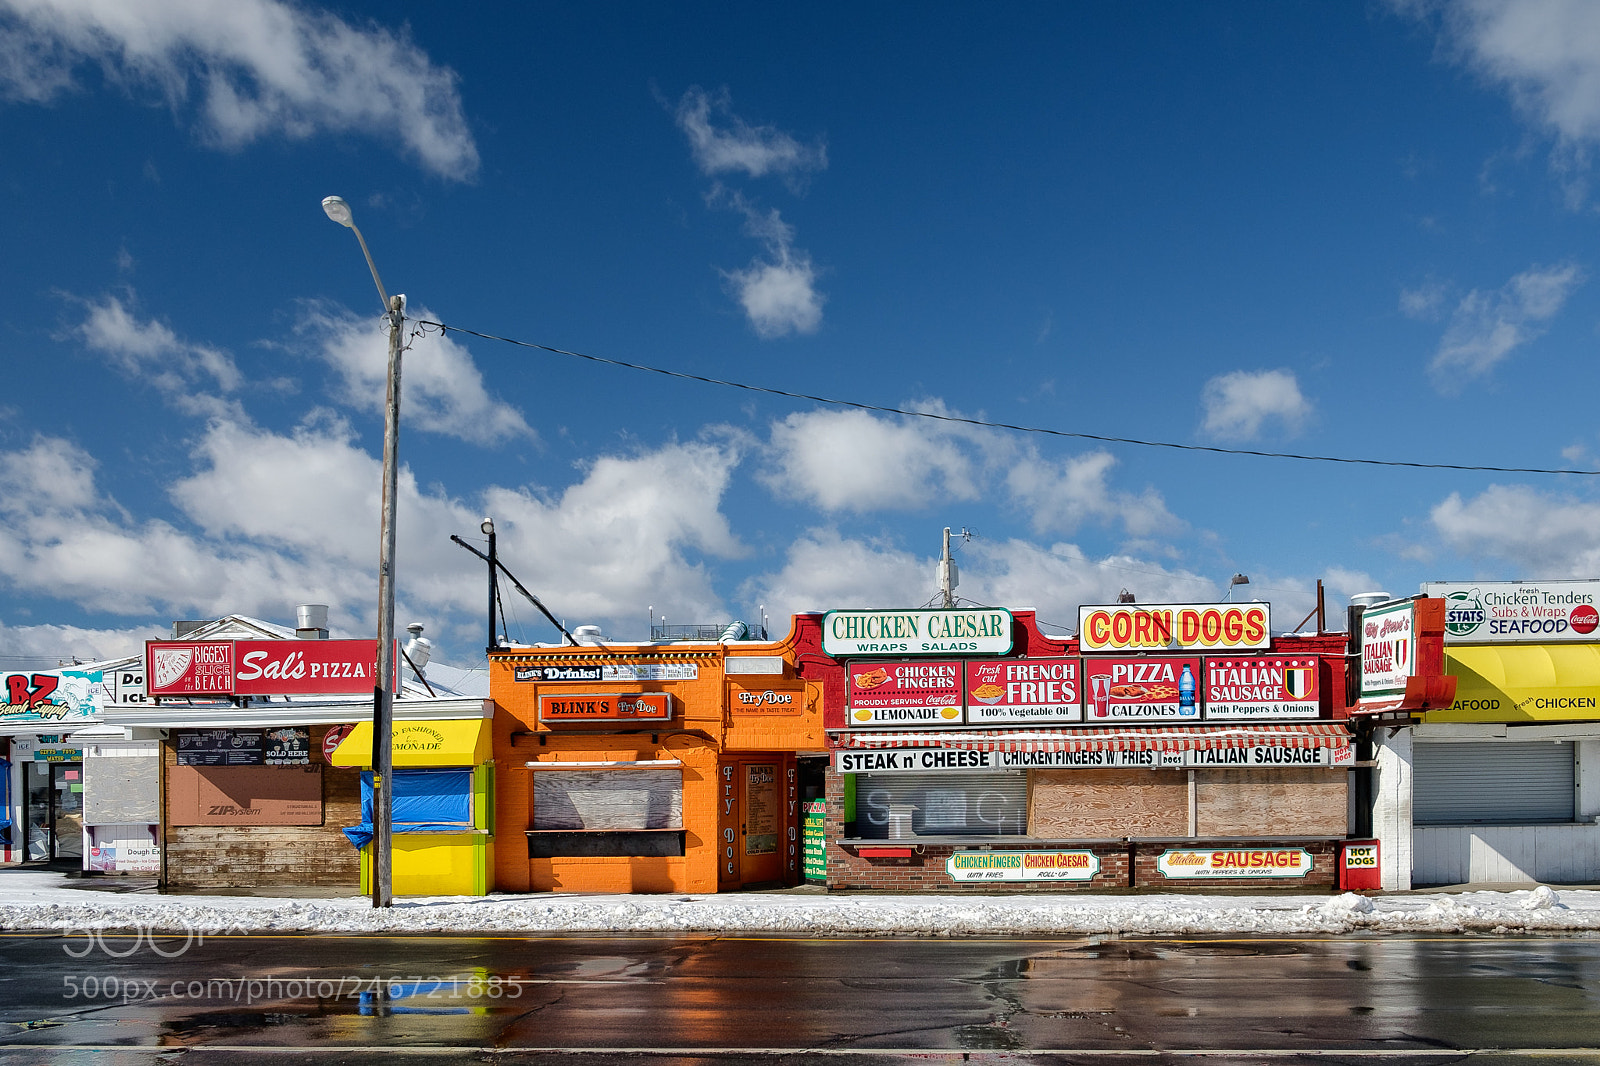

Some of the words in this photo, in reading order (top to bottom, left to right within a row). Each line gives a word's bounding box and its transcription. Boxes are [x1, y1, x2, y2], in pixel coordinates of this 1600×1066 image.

[1484, 592, 1538, 606] Chicken
[1541, 591, 1593, 605] Tenders
[1519, 587, 1540, 595] fresh
[1448, 610, 1484, 622] STATS
[1491, 606, 1518, 618] Subs
[1521, 606, 1530, 618] &
[1532, 605, 1566, 620] Wraps
[832, 615, 920, 640] CHICKEN
[927, 613, 1004, 639] CAESAR
[1084, 609, 1173, 648] CORN
[1177, 608, 1267, 646] DOGS
[1489, 618, 1568, 635] SEAFOOD
[194, 645, 230, 663] BIGGEST
[857, 643, 908, 652] WRAPS
[921, 642, 978, 651] SALADS
[1364, 641, 1393, 660] ITALIAN
[194, 664, 231, 676] SLICE
[236, 650, 307, 681] Sal's
[310, 662, 366, 678] PIZZA
[895, 665, 956, 678] CHICKEN
[974, 663, 1003, 677] fresh
[1006, 664, 1075, 681] FRENCH
[1363, 657, 1393, 675] SAUSAGE
[543, 667, 600, 680] Drinks!
[981, 674, 997, 683] cut
[1112, 663, 1176, 684] PIZZA
[1210, 668, 1283, 686] ITALIAN
[195, 675, 231, 691] BEACH
[897, 677, 955, 689] FINGERS
[5, 674, 59, 709] BZ
[1006, 681, 1077, 703] FRIES
[1210, 686, 1284, 701] SAUSAGE
[0, 700, 30, 716] Beach
[31, 700, 71, 720] Supply
[550, 701, 610, 714] BLINK'S
[1111, 705, 1176, 717] CALZONES
[1210, 705, 1230, 714] with
[1232, 705, 1270, 715] Peppers
[1272, 704, 1280, 713] &
[1282, 704, 1315, 713] Onions
[1440, 699, 1500, 712] AFOOD
[1513, 695, 1534, 712] Fresh
[1534, 697, 1597, 710] CHICKEN
[874, 708, 940, 721] LEMONADE
[980, 707, 1007, 717] 100%
[1008, 707, 1054, 718] Vegetable
[1055, 706, 1069, 716] Oil
[401, 726, 445, 743] FASHIONED
[391, 742, 442, 751] EMONADE
[842, 752, 898, 770] STEAK
[921, 750, 990, 768] CHEESE
[1003, 750, 1052, 765] CHICKEN
[1056, 750, 1102, 764] FINGERS
[1122, 749, 1153, 764] FRIES
[1163, 756, 1182, 764] DOGS
[1194, 747, 1248, 764] ITALIAN
[1255, 747, 1321, 763] SAUSAGE
[1335, 751, 1351, 763] DOGS
[722, 765, 736, 816] Fry
[787, 768, 797, 817] Fry
[802, 801, 827, 813] PIZZA
[127, 848, 150, 857] Dough
[723, 827, 735, 875] Doe
[787, 826, 797, 872] Doe
[1350, 847, 1372, 857] HOT
[954, 854, 989, 869] CHICKEN
[989, 854, 1021, 868] FINGERS
[1024, 853, 1056, 868] CHICKEN
[1056, 853, 1089, 868] CAESAR
[1167, 852, 1207, 866] Italian
[1211, 850, 1302, 869] SAUSAGE
[1347, 857, 1375, 866] DOGS
